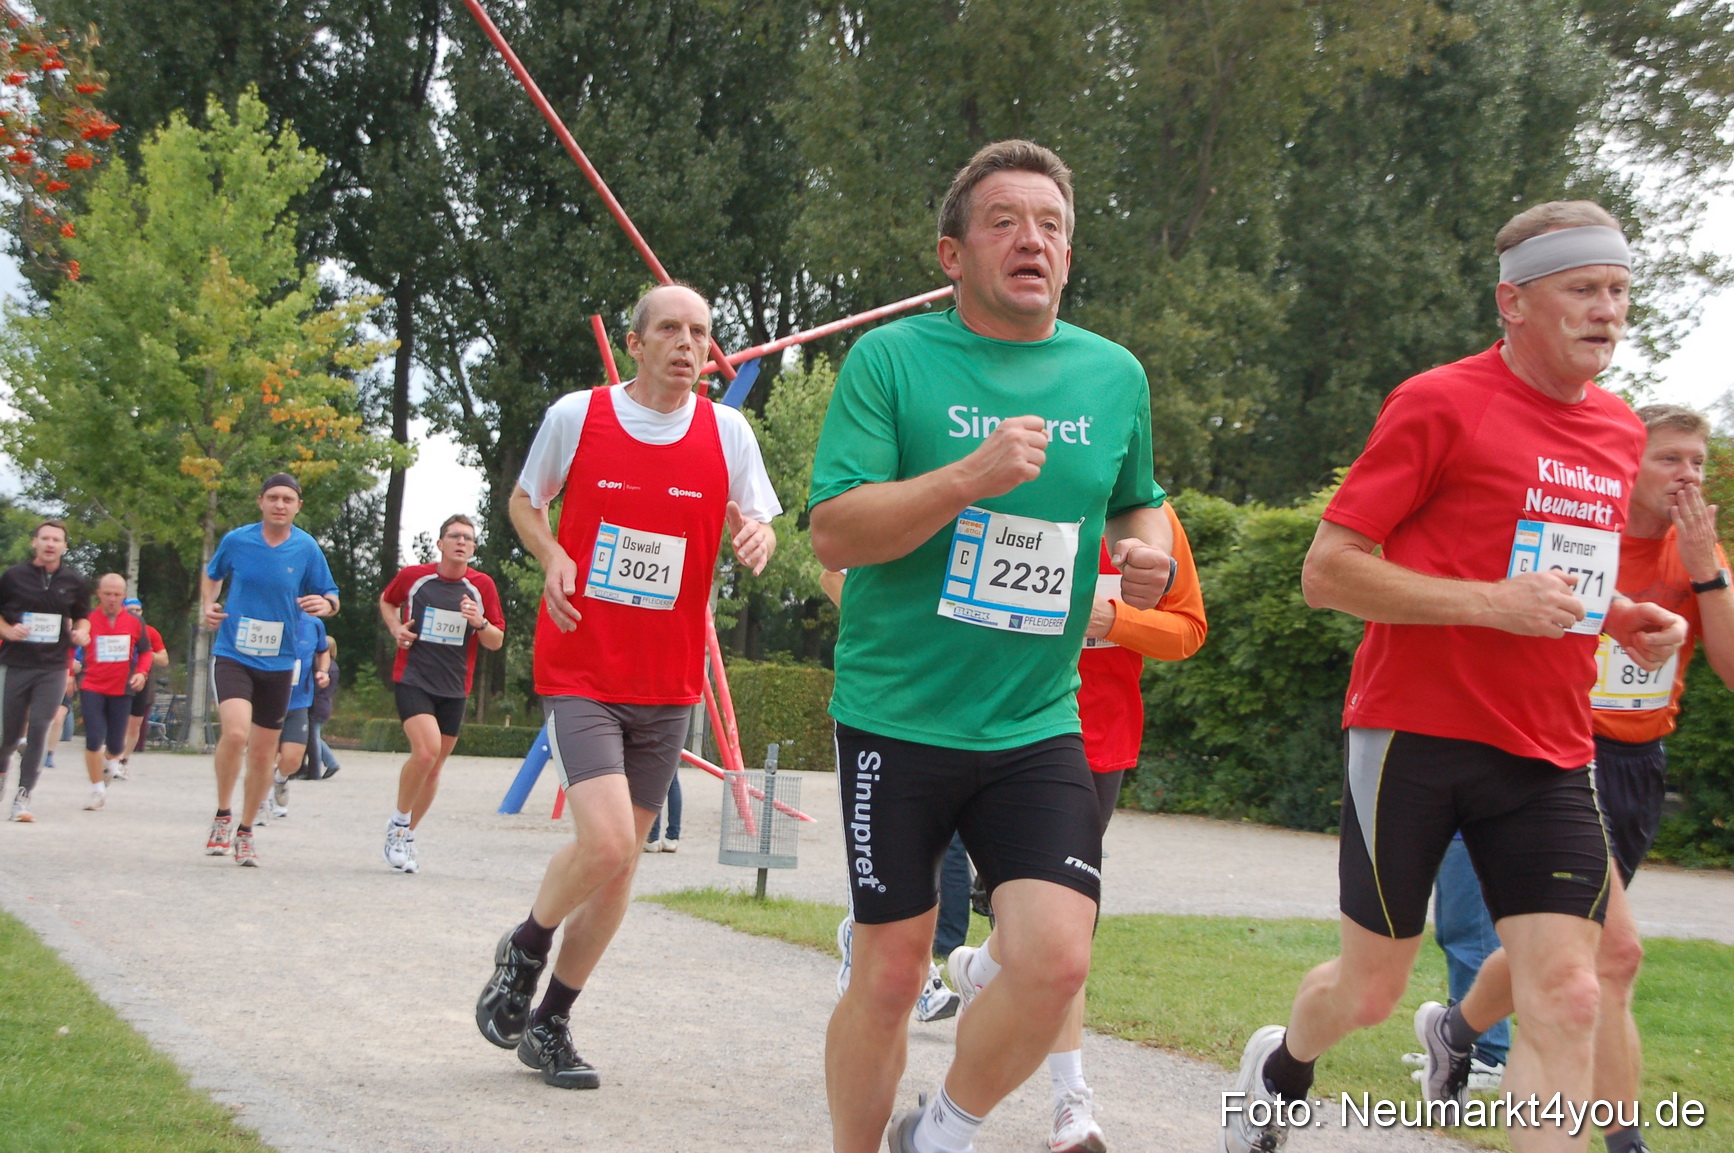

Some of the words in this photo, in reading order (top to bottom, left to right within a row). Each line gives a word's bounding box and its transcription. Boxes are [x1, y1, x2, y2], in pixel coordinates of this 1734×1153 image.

[948, 405, 1091, 445] Sinret
[1537, 456, 1622, 498] Klinikum
[1525, 487, 1614, 526] Neumarkt
[622, 535, 661, 555] Oswald
[995, 526, 1044, 551] Josef
[1551, 532, 1596, 557] Werner
[598, 551, 606, 562] C
[960, 550, 970, 565] C
[1520, 558, 1529, 572] C
[618, 558, 670, 584] 3021
[989, 559, 1066, 595] 2232
[1550, 564, 1604, 597] 571
[435, 622, 461, 633] 3701
[1023, 615, 1064, 628] PFLEIDERER
[250, 634, 277, 644] 3119
[851, 750, 882, 889] Sinupret
